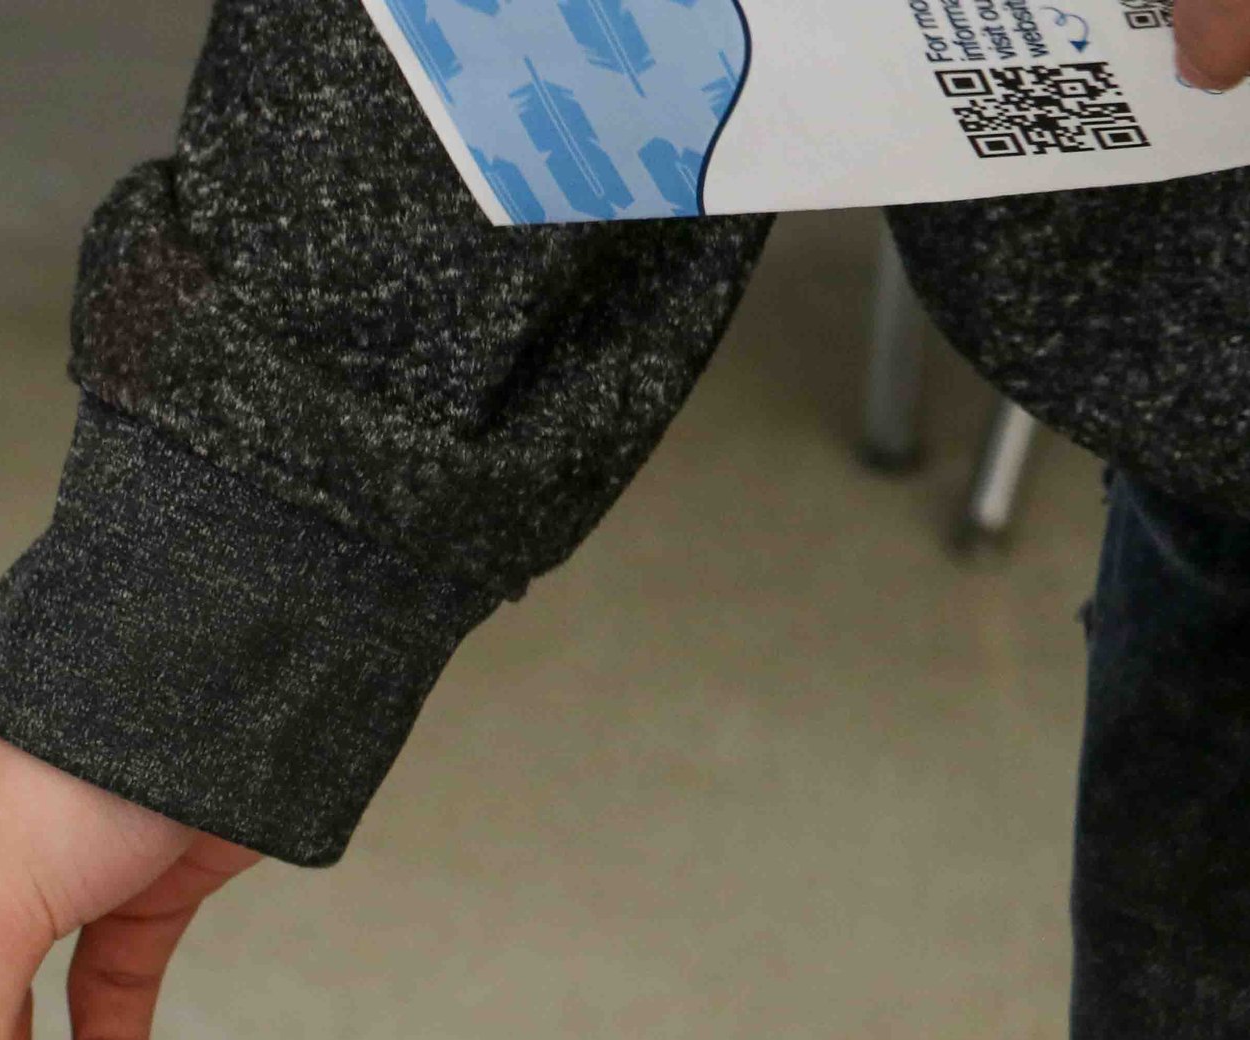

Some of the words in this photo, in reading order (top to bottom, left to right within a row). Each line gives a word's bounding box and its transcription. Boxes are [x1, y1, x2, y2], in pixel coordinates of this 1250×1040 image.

[909, 0, 939, 29] mo
[975, 0, 1000, 21] ou
[941, 0, 986, 61] informa
[980, 26, 1017, 59] visit
[1000, 0, 1049, 58] websit
[923, 33, 953, 62] For
